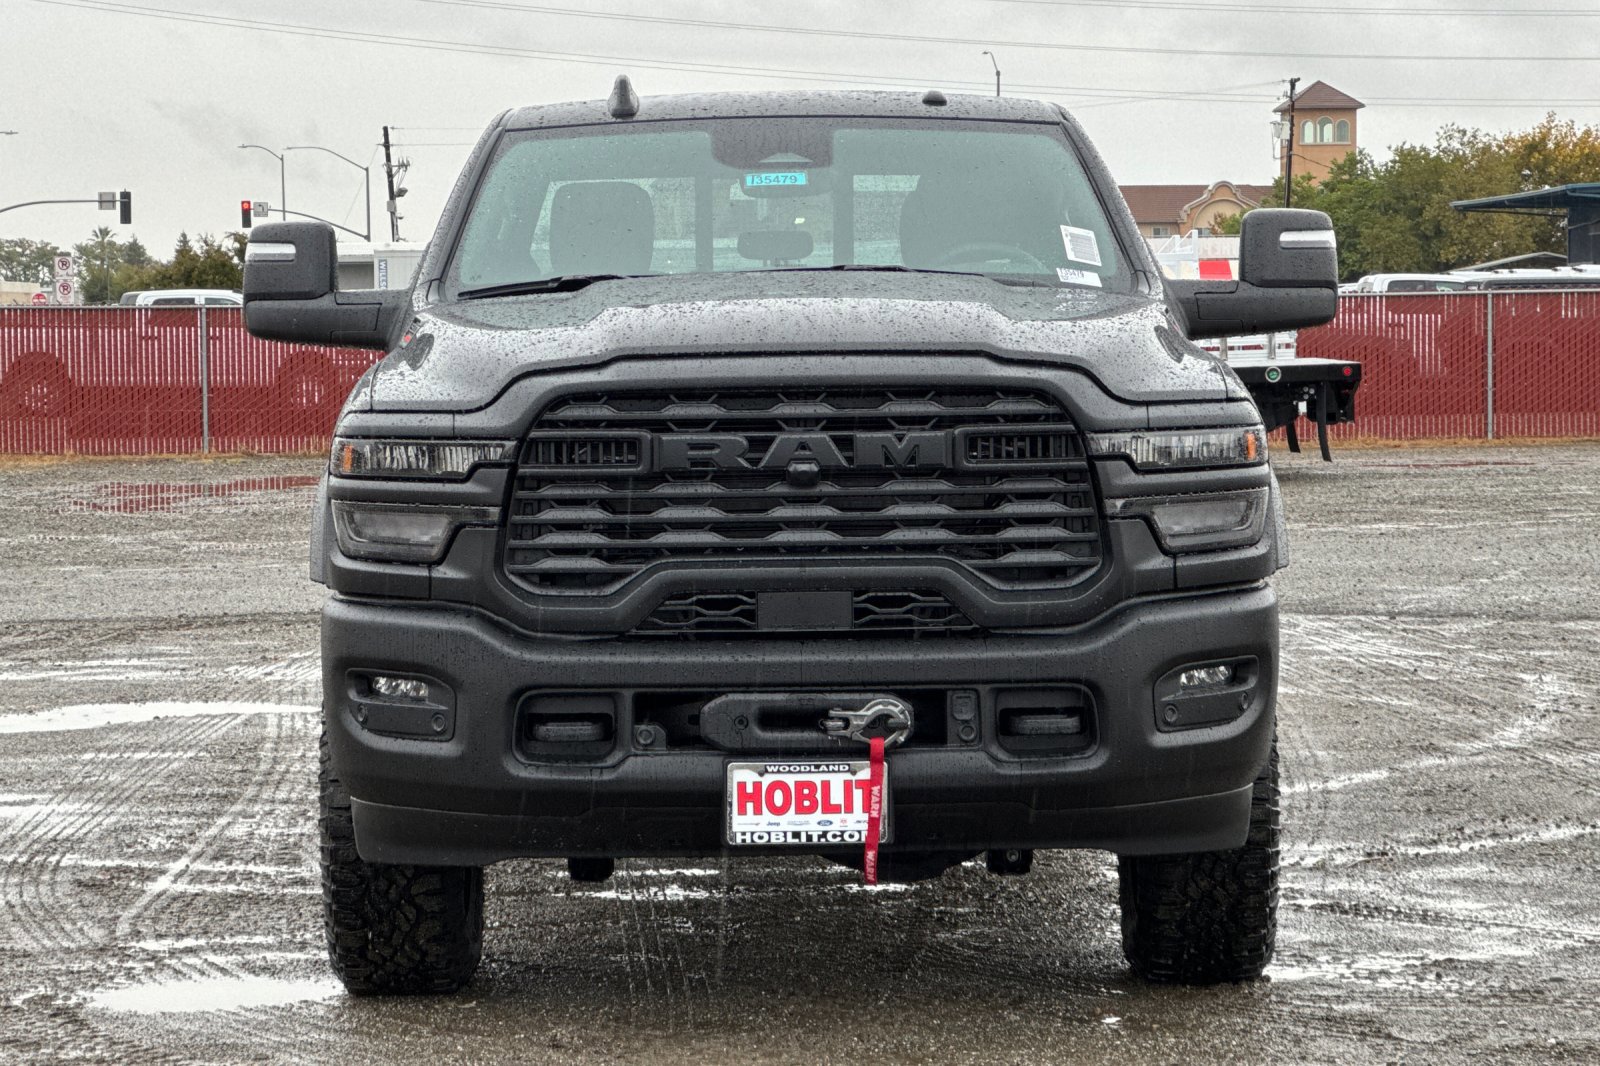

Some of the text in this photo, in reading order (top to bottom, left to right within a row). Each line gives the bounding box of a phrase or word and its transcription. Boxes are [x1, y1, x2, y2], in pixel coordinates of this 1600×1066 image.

[379, 260, 387, 289] WILLS
[660, 433, 946, 470] RAM
[766, 764, 849, 773] WOODLAND
[736, 780, 871, 816] HOBLIT
[870, 785, 881, 818] WARN
[866, 850, 876, 881] WARN
